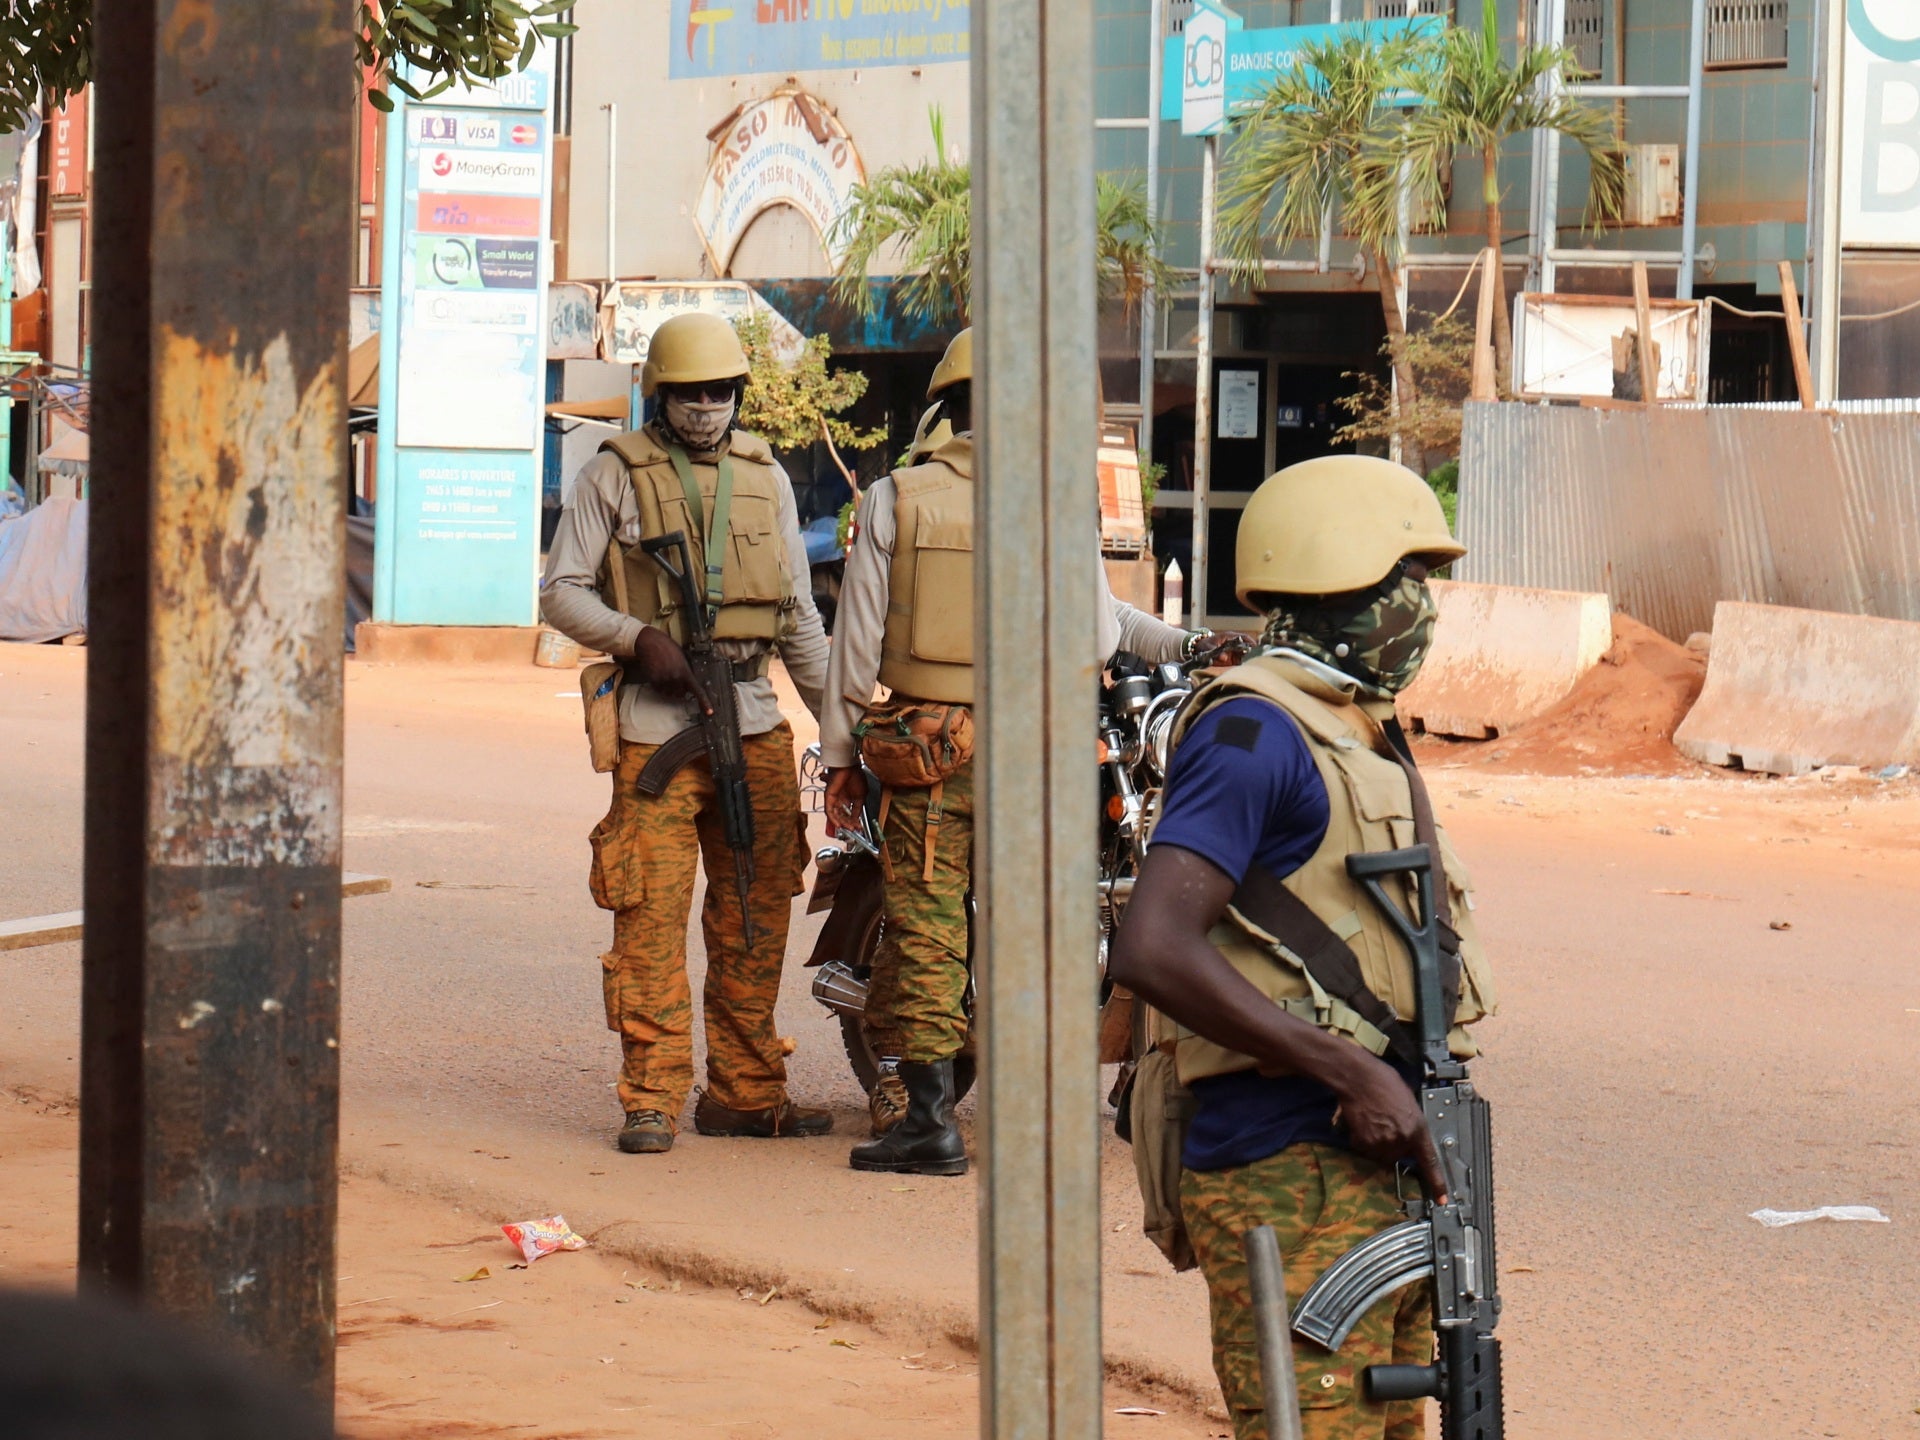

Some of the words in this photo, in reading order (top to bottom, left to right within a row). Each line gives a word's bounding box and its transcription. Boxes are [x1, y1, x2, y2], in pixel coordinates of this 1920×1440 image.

[1185, 35, 1223, 88] BCB
[1230, 51, 1273, 72] BANQUE
[467, 127, 495, 139] VISA
[713, 110, 767, 189] FASO
[784, 101, 848, 169] MTO
[456, 161, 535, 178] MoneyGram
[728, 173, 739, 193] DE
[432, 203, 468, 225] Ria
[482, 249, 506, 260] Small
[508, 250, 534, 261] World
